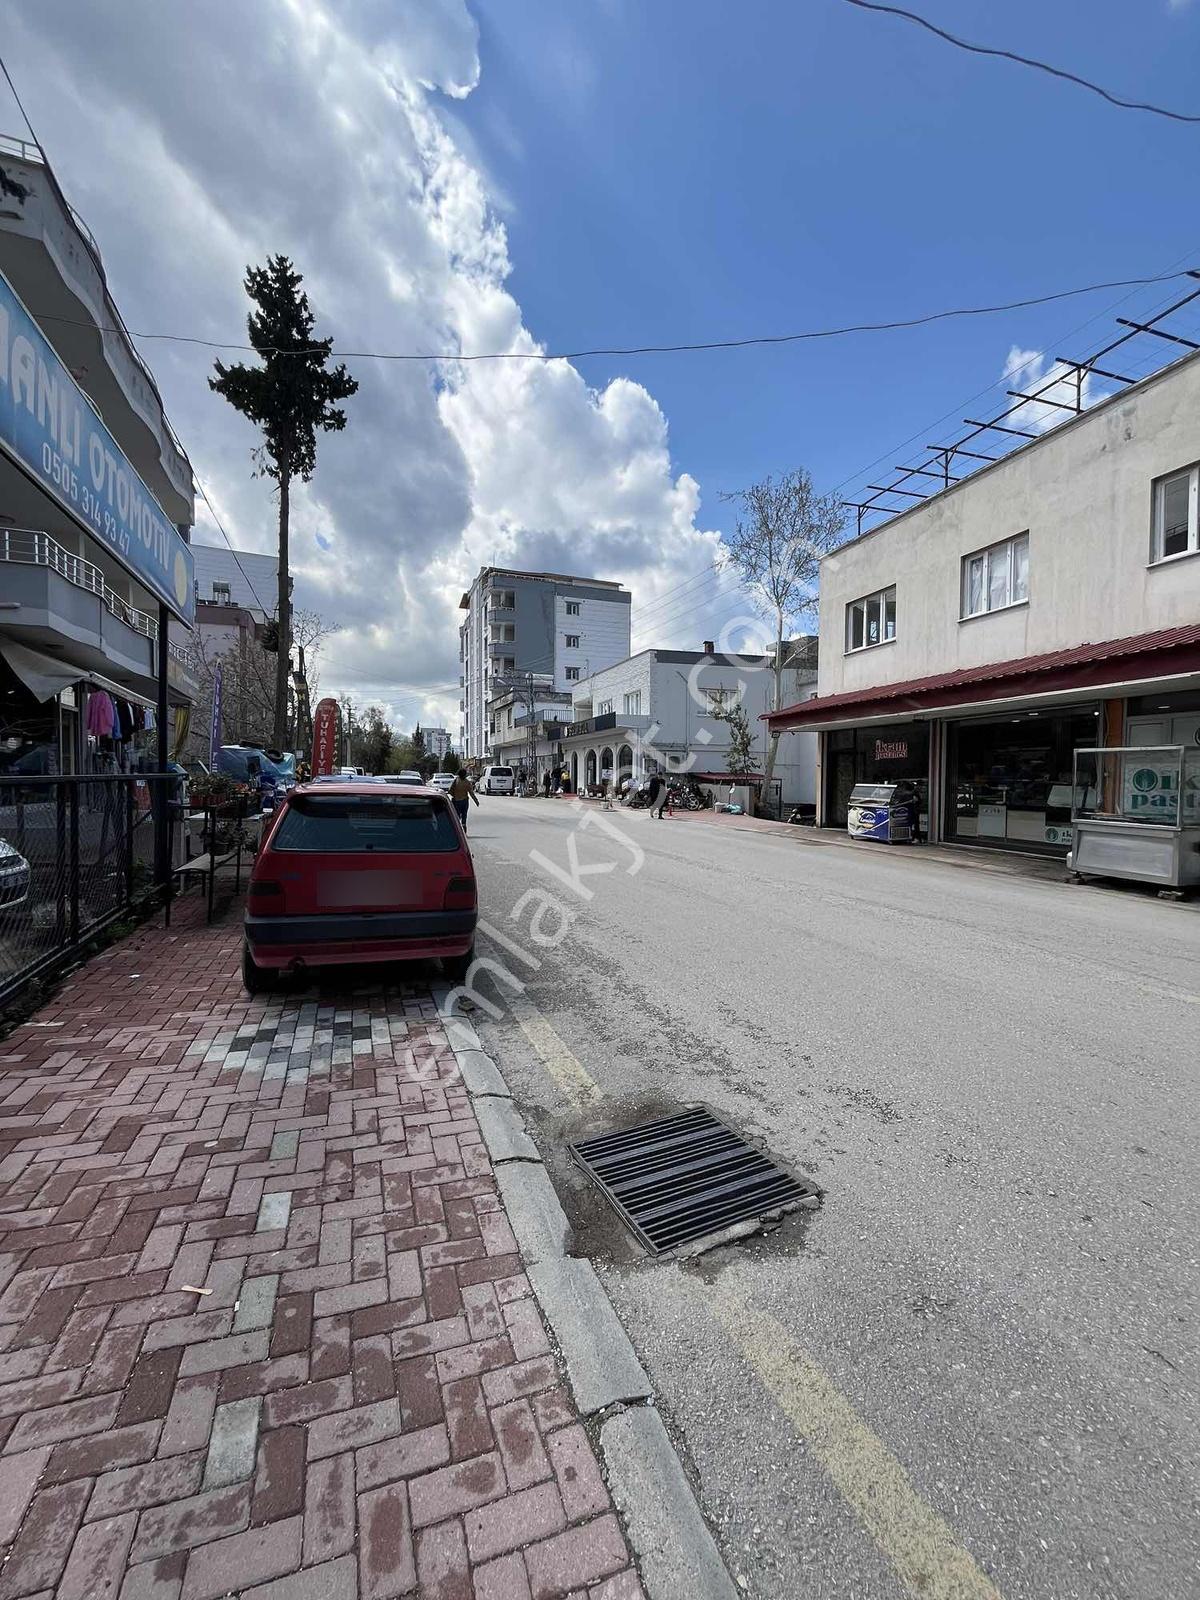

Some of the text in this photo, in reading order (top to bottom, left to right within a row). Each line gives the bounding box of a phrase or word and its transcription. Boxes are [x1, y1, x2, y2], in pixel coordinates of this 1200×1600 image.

[42, 442, 130, 556] 0505 314 93 47
